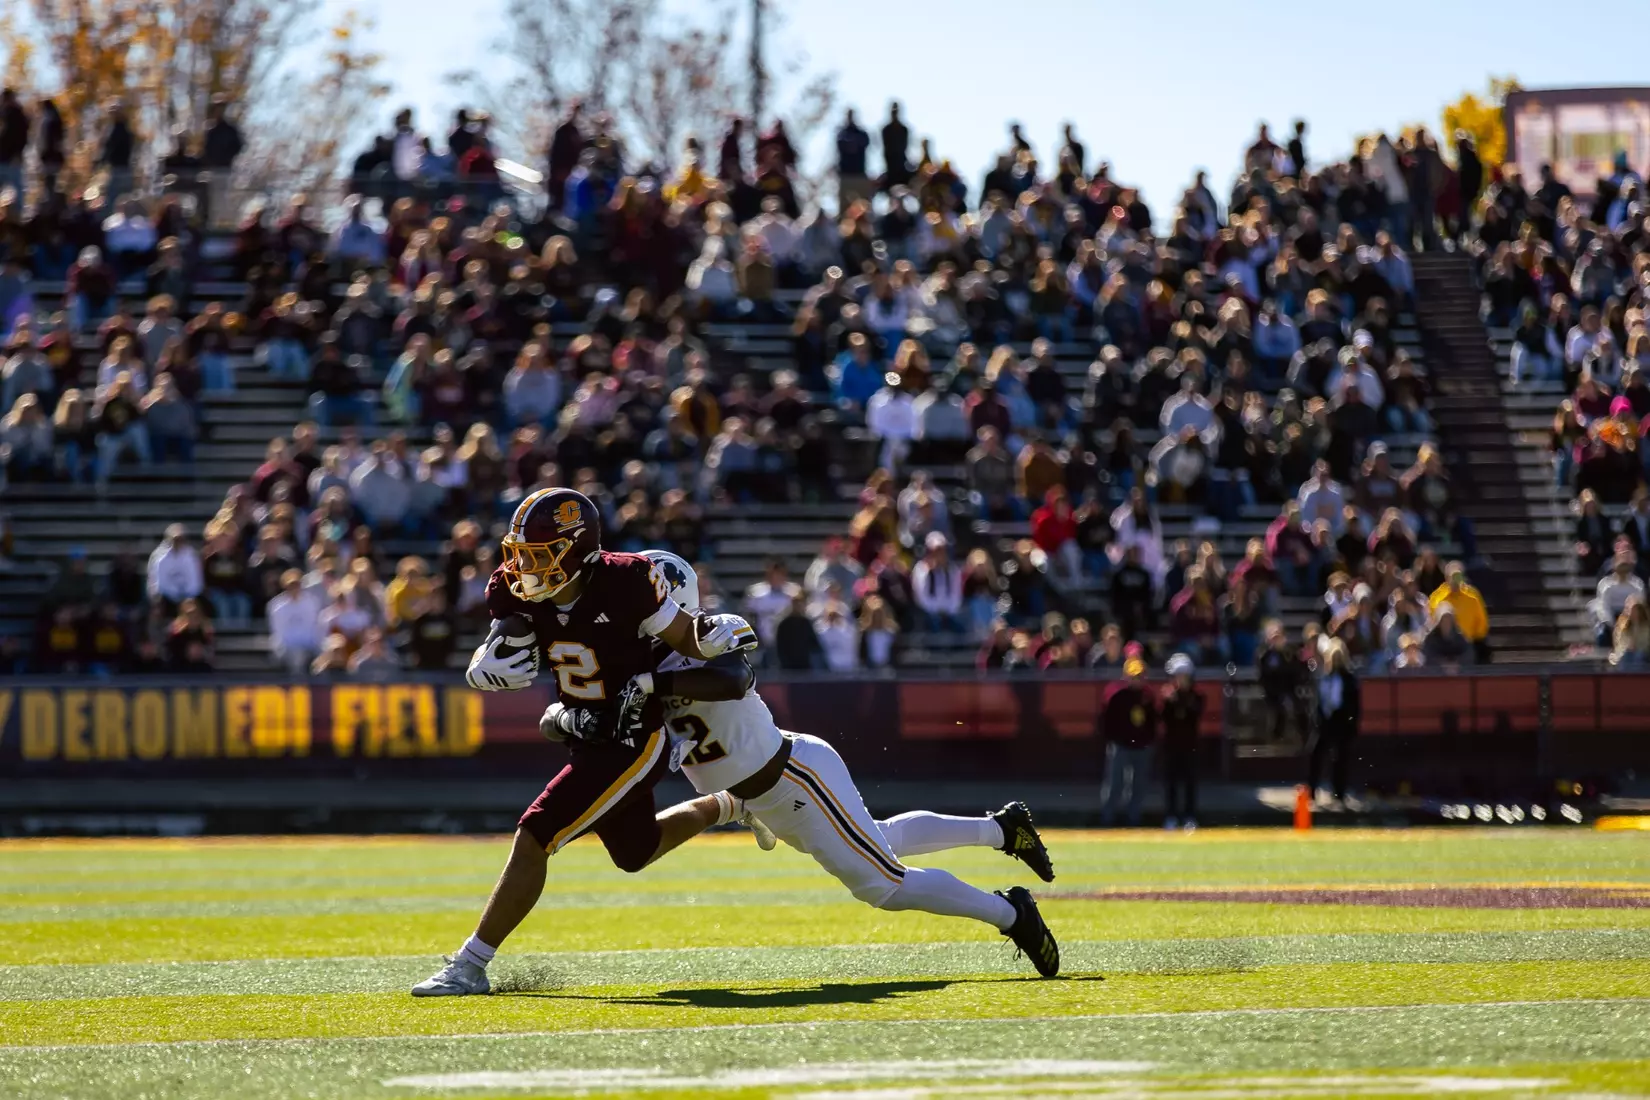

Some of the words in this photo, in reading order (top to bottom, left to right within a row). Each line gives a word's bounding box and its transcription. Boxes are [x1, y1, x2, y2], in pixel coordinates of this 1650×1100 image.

[547, 641, 606, 700] 2
[331, 685, 484, 758] FIELD
[669, 714, 729, 766] 2
